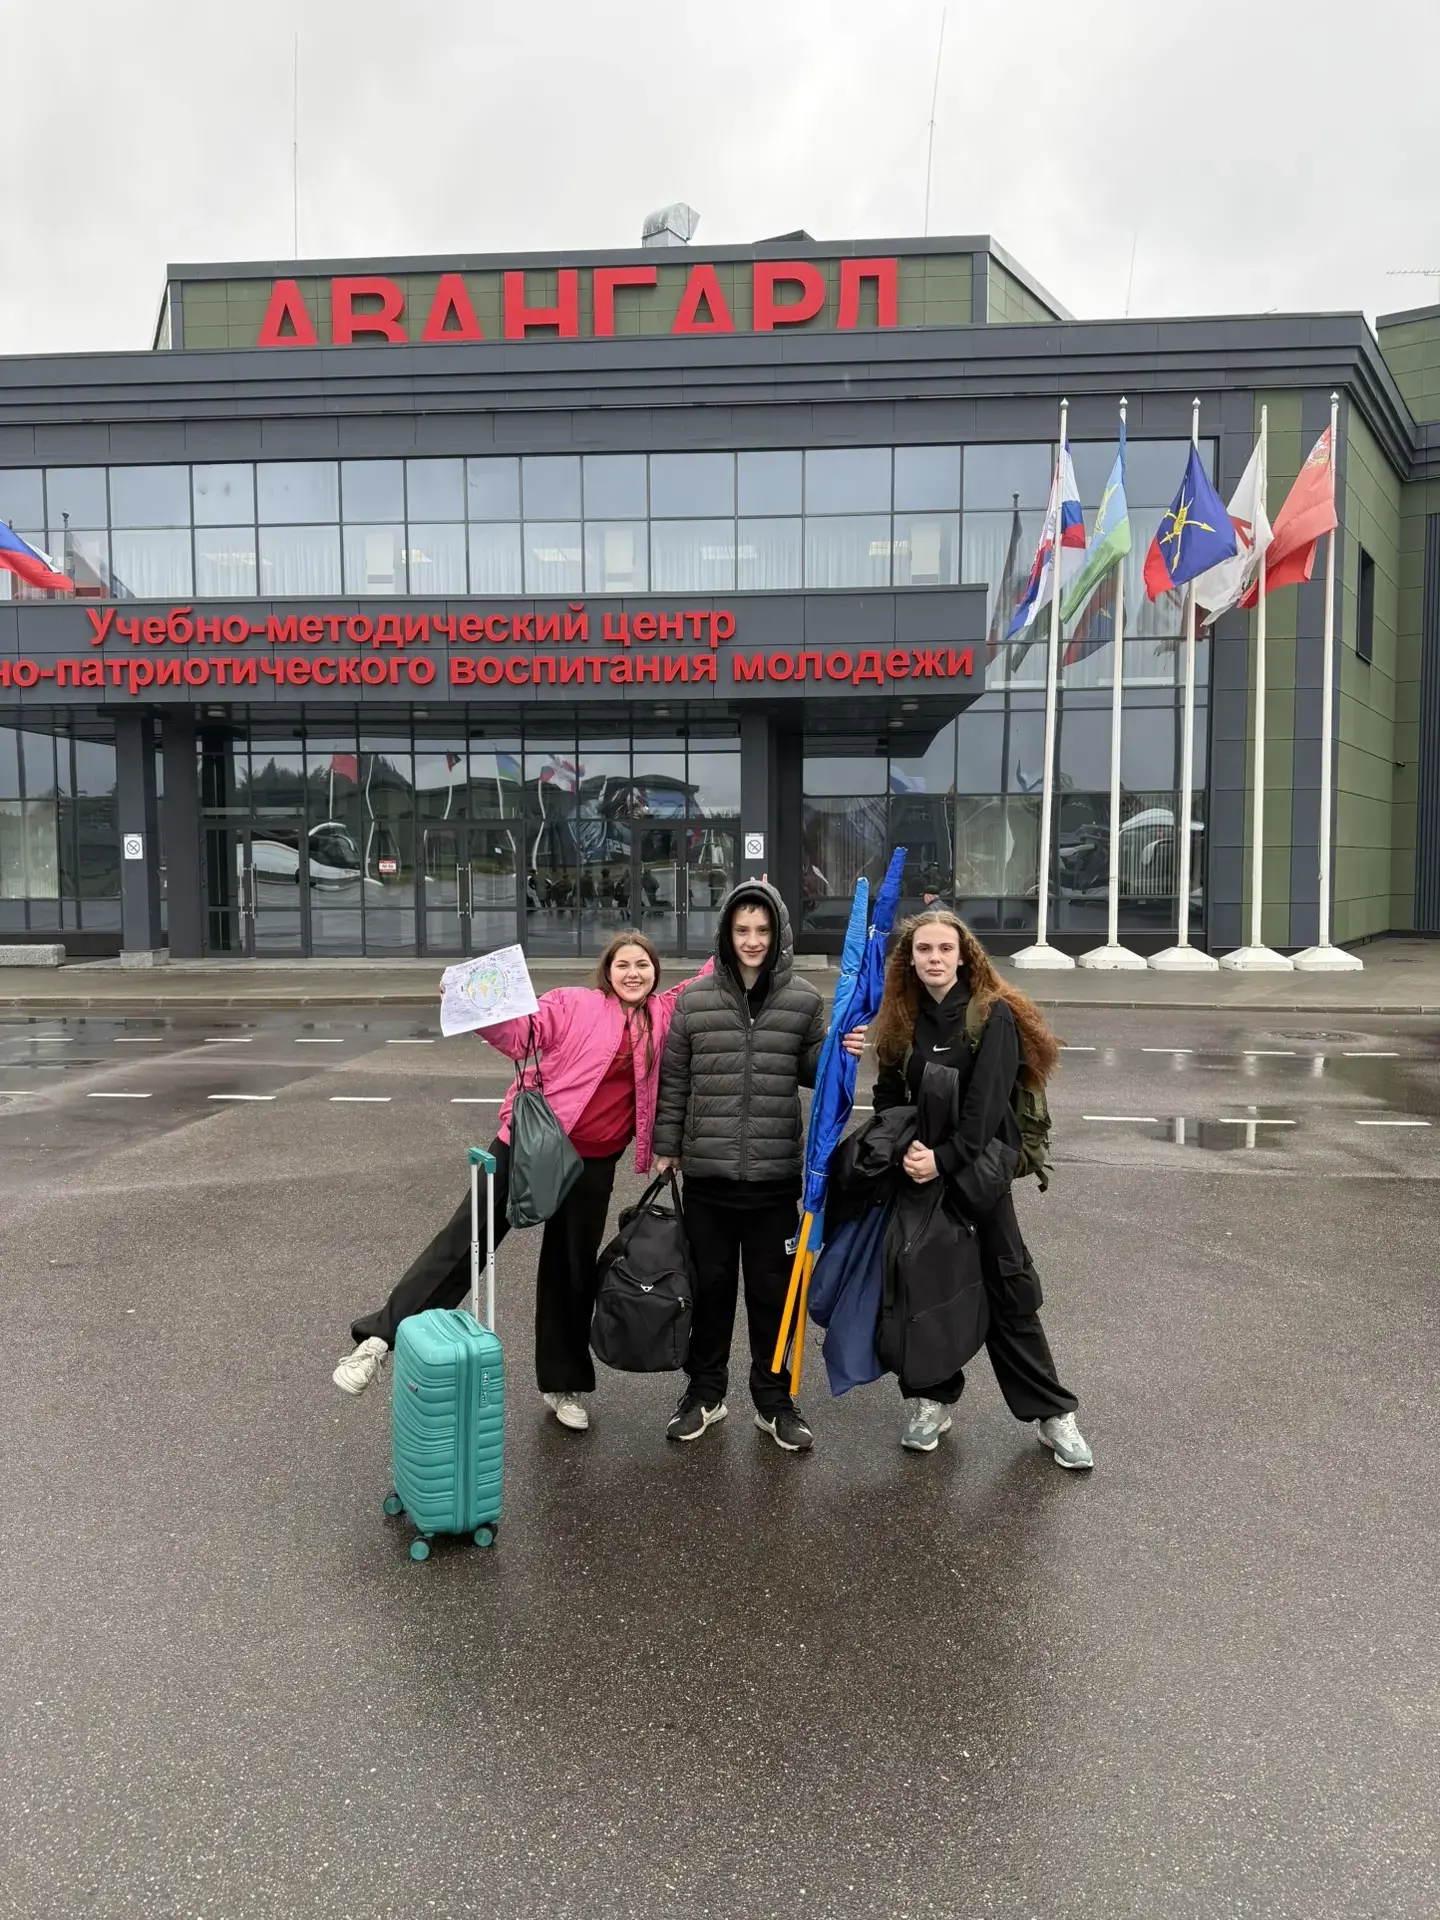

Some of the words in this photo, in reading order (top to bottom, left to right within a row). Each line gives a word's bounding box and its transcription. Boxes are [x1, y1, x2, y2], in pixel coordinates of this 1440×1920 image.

[87, 604, 588, 649] Учебно-методический
[602, 611, 736, 648] центр
[450, 654, 717, 685] воспитания
[732, 648, 974, 685] молодежи
